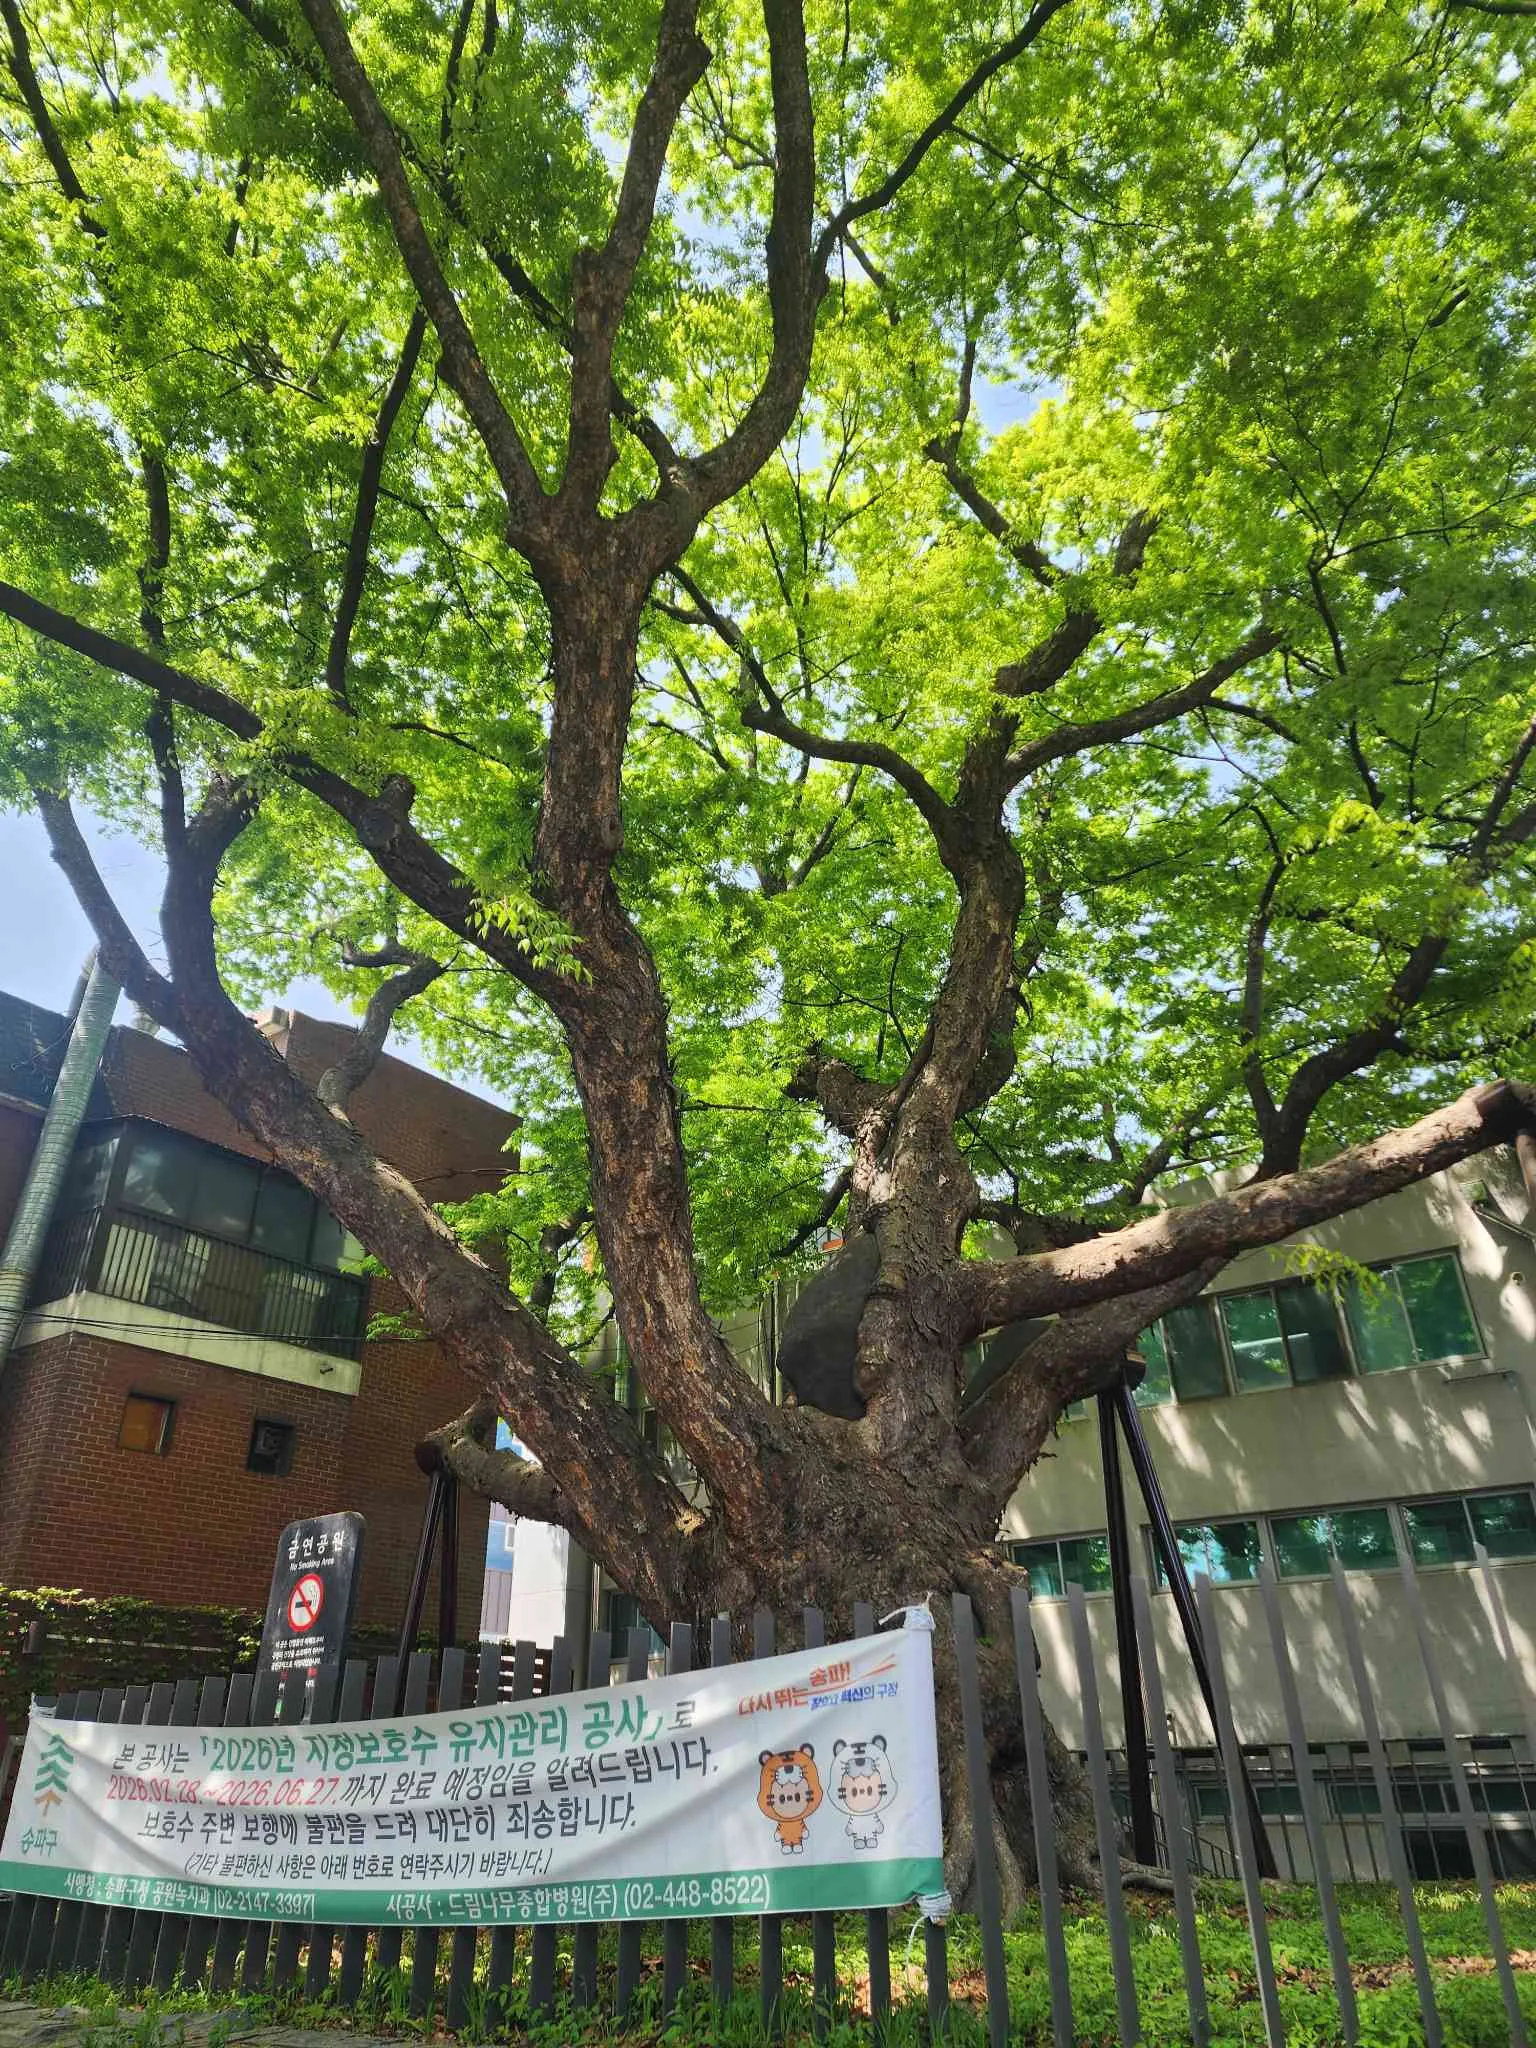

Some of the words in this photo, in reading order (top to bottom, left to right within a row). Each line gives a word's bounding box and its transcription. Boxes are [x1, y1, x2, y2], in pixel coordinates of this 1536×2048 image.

[288, 1530, 345, 1560] 금연공원
[290, 1562, 298, 1572] No
[298, 1560, 320, 1570] Smoking
[321, 1557, 334, 1566] Area
[738, 1691, 772, 1716] 다시
[774, 1686, 809, 1710] 뛰는
[810, 1660, 852, 1687] 송파!
[841, 1684, 875, 1703] 혁신의
[877, 1681, 899, 1698] 구정
[111, 1743, 137, 1770] 본
[136, 1743, 191, 1773] 공사는
[302, 1725, 438, 1772] 지정보호수
[448, 1706, 568, 1763] 유지관리
[391, 1771, 437, 1805] 완료
[443, 1761, 536, 1800] 예정임을
[546, 1736, 719, 1792] 알려드립니다.
[137, 1810, 194, 1843] 보호수
[200, 1812, 235, 1845] 주변
[241, 1812, 298, 1846] 보행에
[304, 1812, 366, 1845] 불편을
[374, 1809, 417, 1843] 드려
[425, 1803, 495, 1843] 대단히
[506, 1792, 636, 1840] 죄송합니다.
[20, 1826, 58, 1856] 송파구
[184, 1851, 220, 1876] (기타
[218, 1853, 272, 1879] 불편하신
[277, 1855, 316, 1880] 사항은
[321, 1854, 347, 1880] 아래
[353, 1854, 394, 1880] 번호로
[400, 1850, 475, 1880] 연락주시기
[480, 1848, 552, 1878] 바랍니다.)
[104, 1876, 150, 1904] 송파구청
[152, 1880, 210, 1911] 공원녹지과
[386, 1893, 432, 1920] 시공사
[449, 1883, 616, 1920] 드림나무종합병원(주)
[624, 1873, 770, 1917] (02-448-8522)
